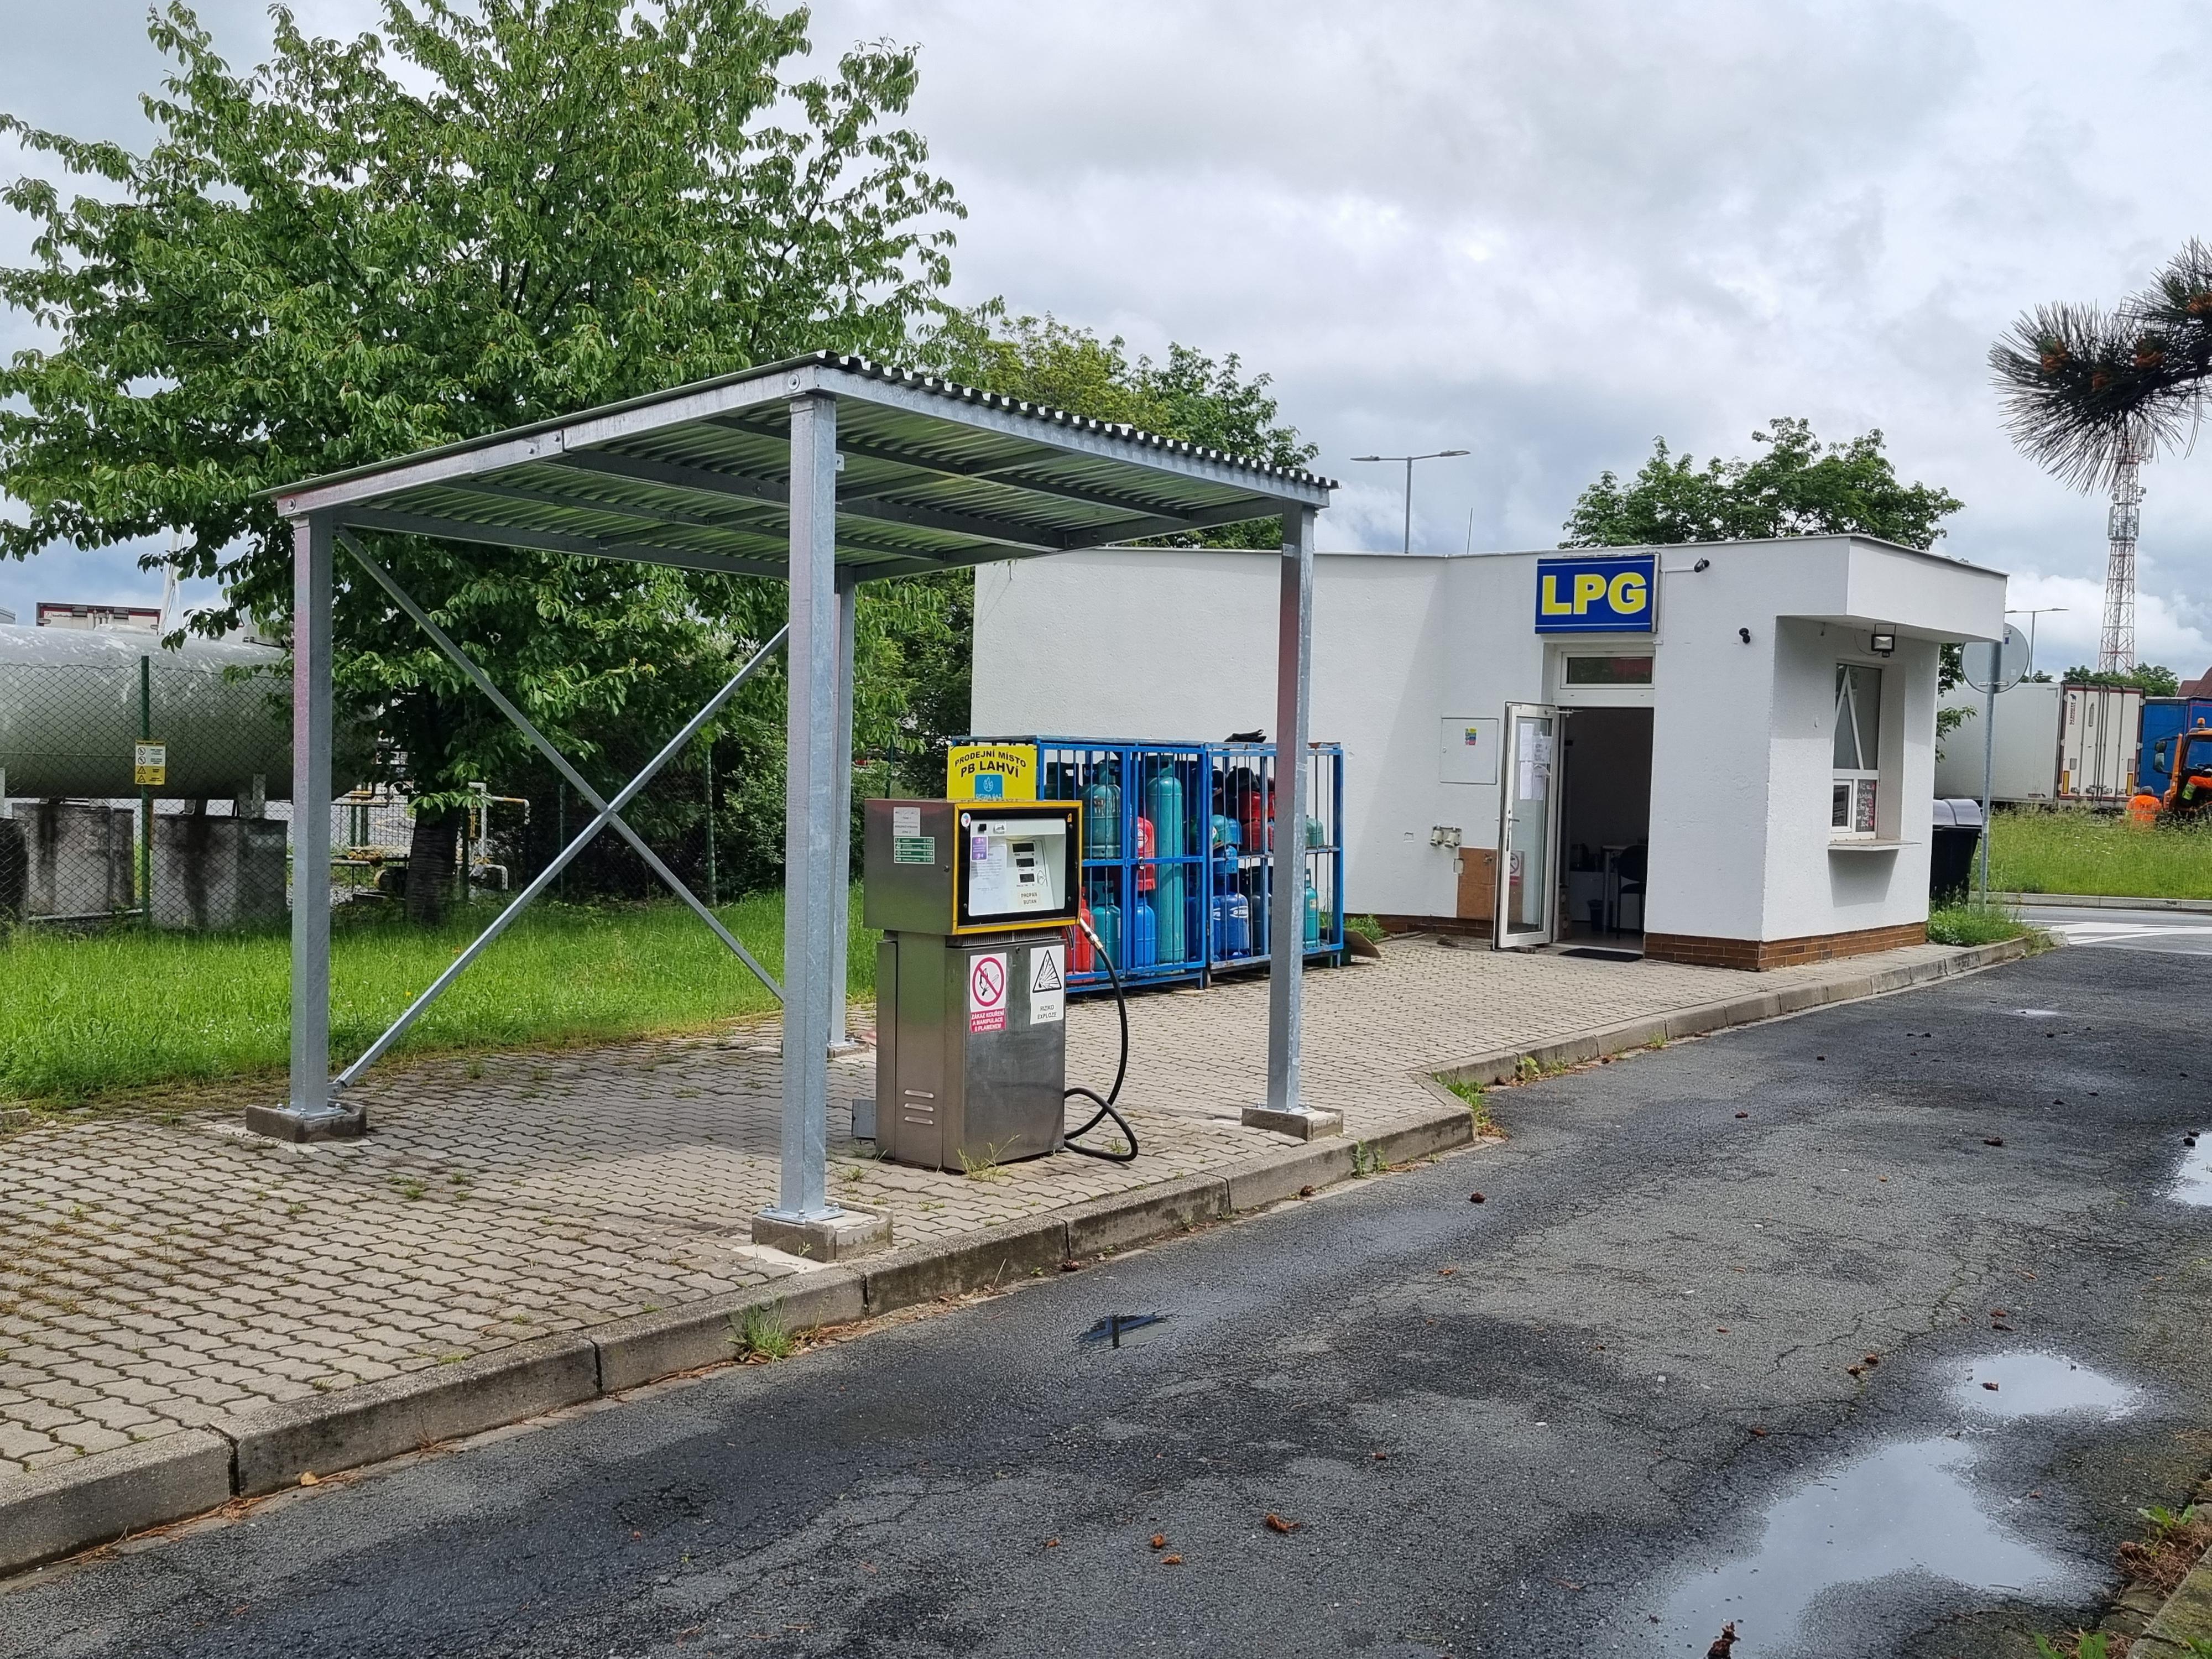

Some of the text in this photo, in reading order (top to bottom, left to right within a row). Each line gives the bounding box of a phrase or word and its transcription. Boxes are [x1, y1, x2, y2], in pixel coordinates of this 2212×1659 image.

[1542, 572, 1646, 615] LPG
[955, 749, 1026, 768] PRODEJNÍ MÍSTO
[961, 760, 1019, 778] PB LAHVÍ
